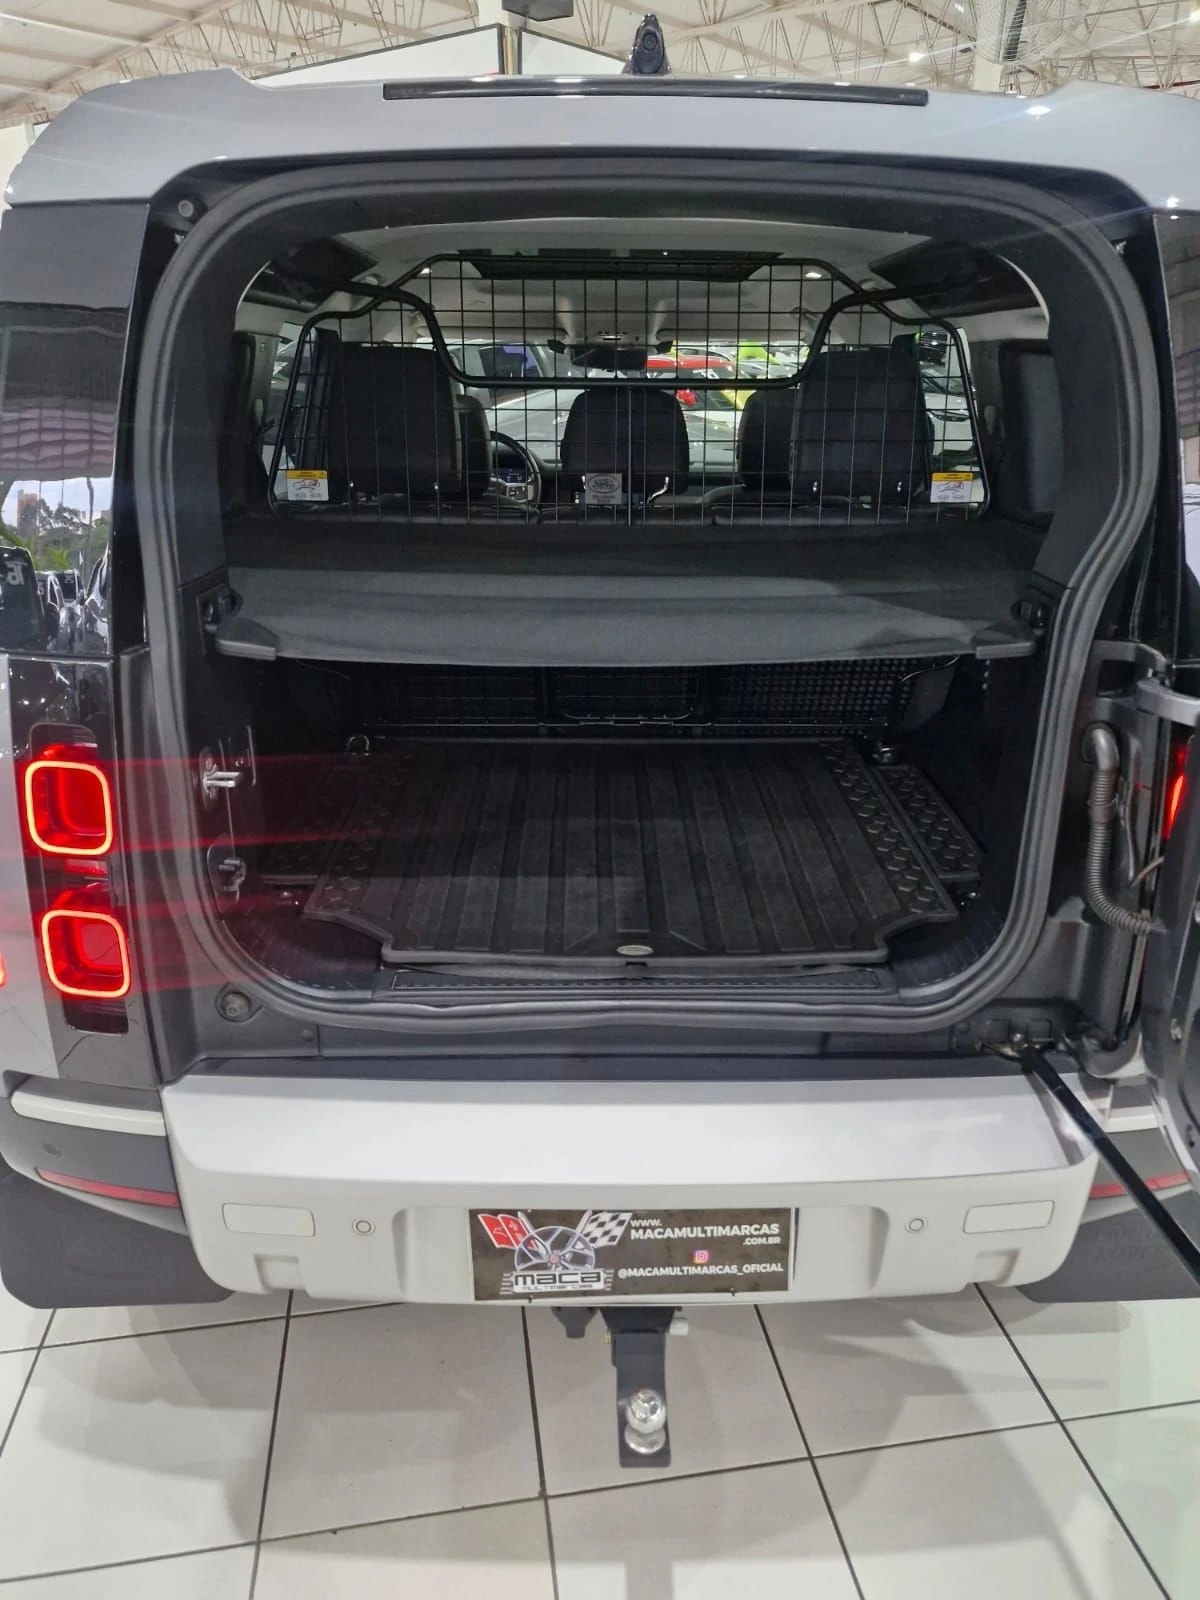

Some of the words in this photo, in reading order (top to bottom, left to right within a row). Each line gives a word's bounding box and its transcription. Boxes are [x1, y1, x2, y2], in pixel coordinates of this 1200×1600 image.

[630, 1223, 780, 1240] MACAMULTIMARCAS
[743, 1236, 781, 1246] .COM.BR
[617, 1263, 784, 1279] @MACAMULTIMARCAS_OFICIAL
